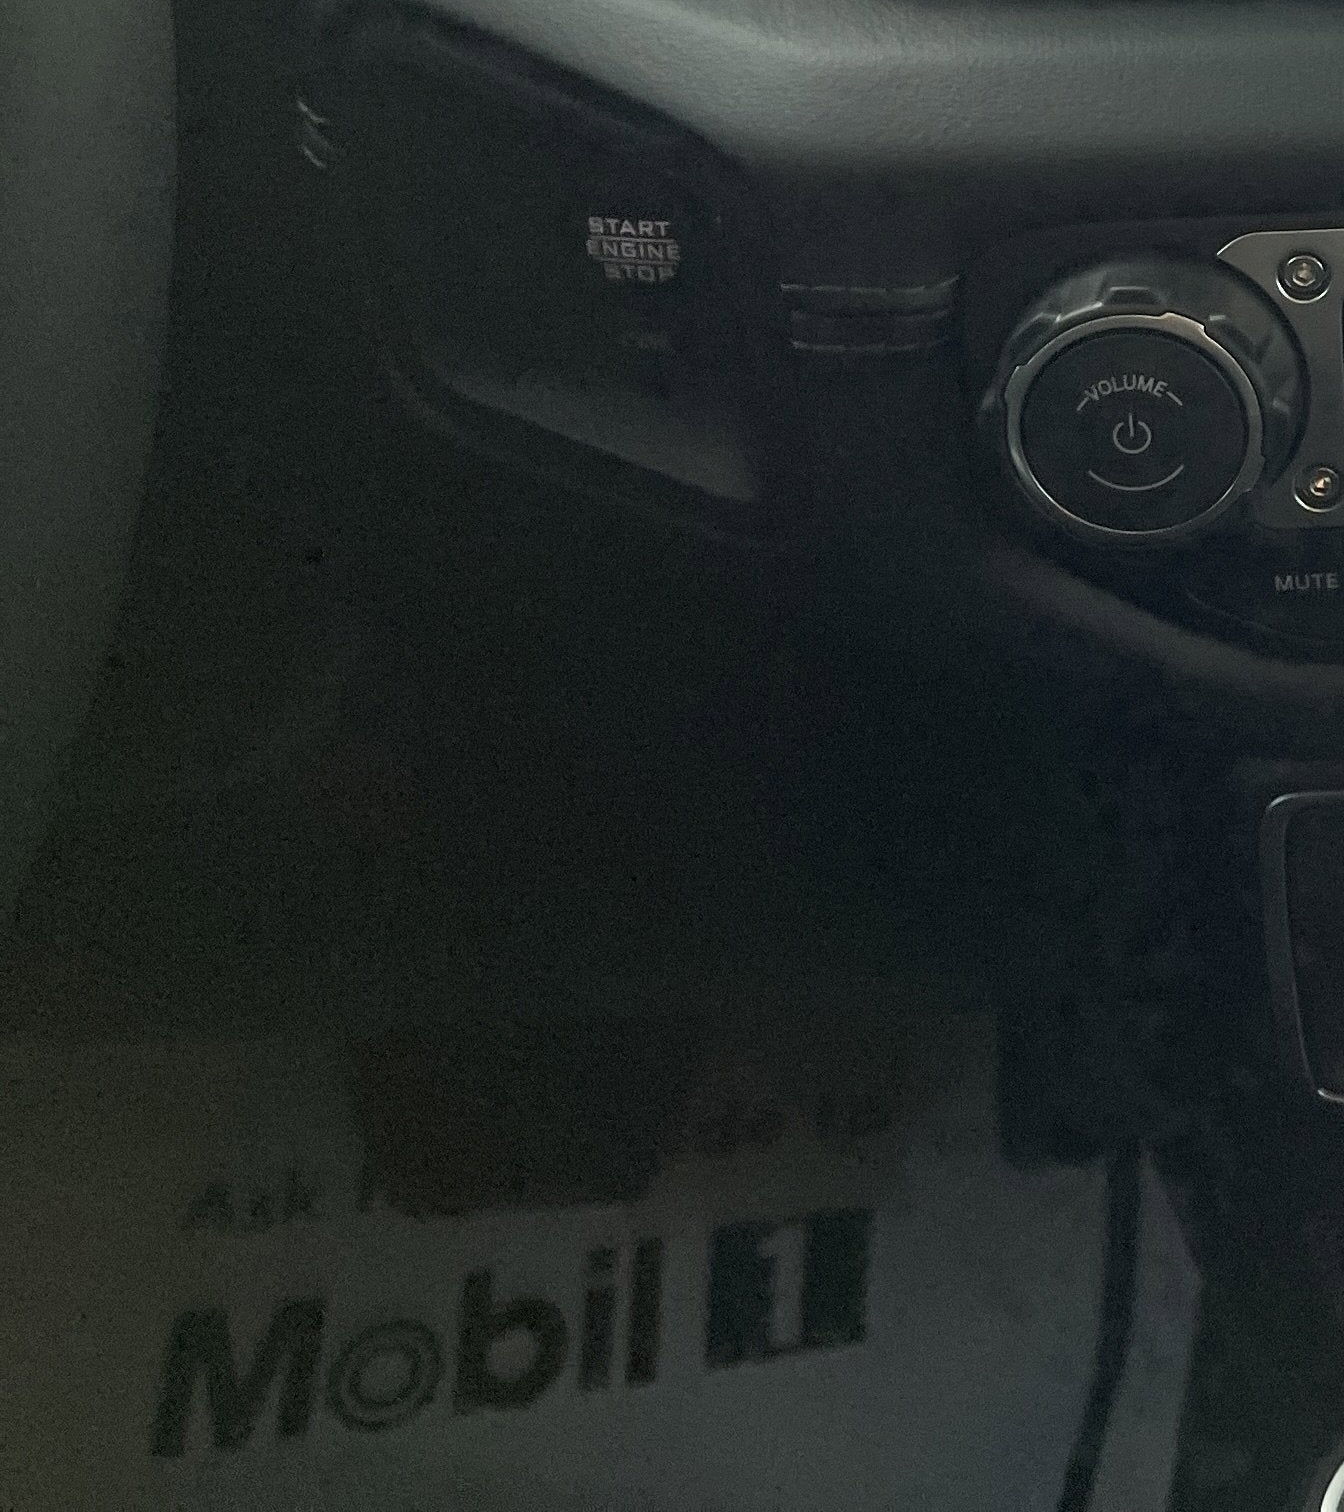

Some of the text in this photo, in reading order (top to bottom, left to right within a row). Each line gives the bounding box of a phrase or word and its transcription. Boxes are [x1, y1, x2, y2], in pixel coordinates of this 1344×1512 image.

[588, 216, 671, 237] START
[585, 239, 681, 260] ENGINE
[603, 263, 676, 282] STOP
[1085, 375, 1168, 403] VOLUME
[1274, 572, 1340, 592] MUTE
[148, 1236, 665, 1460] Mobil
